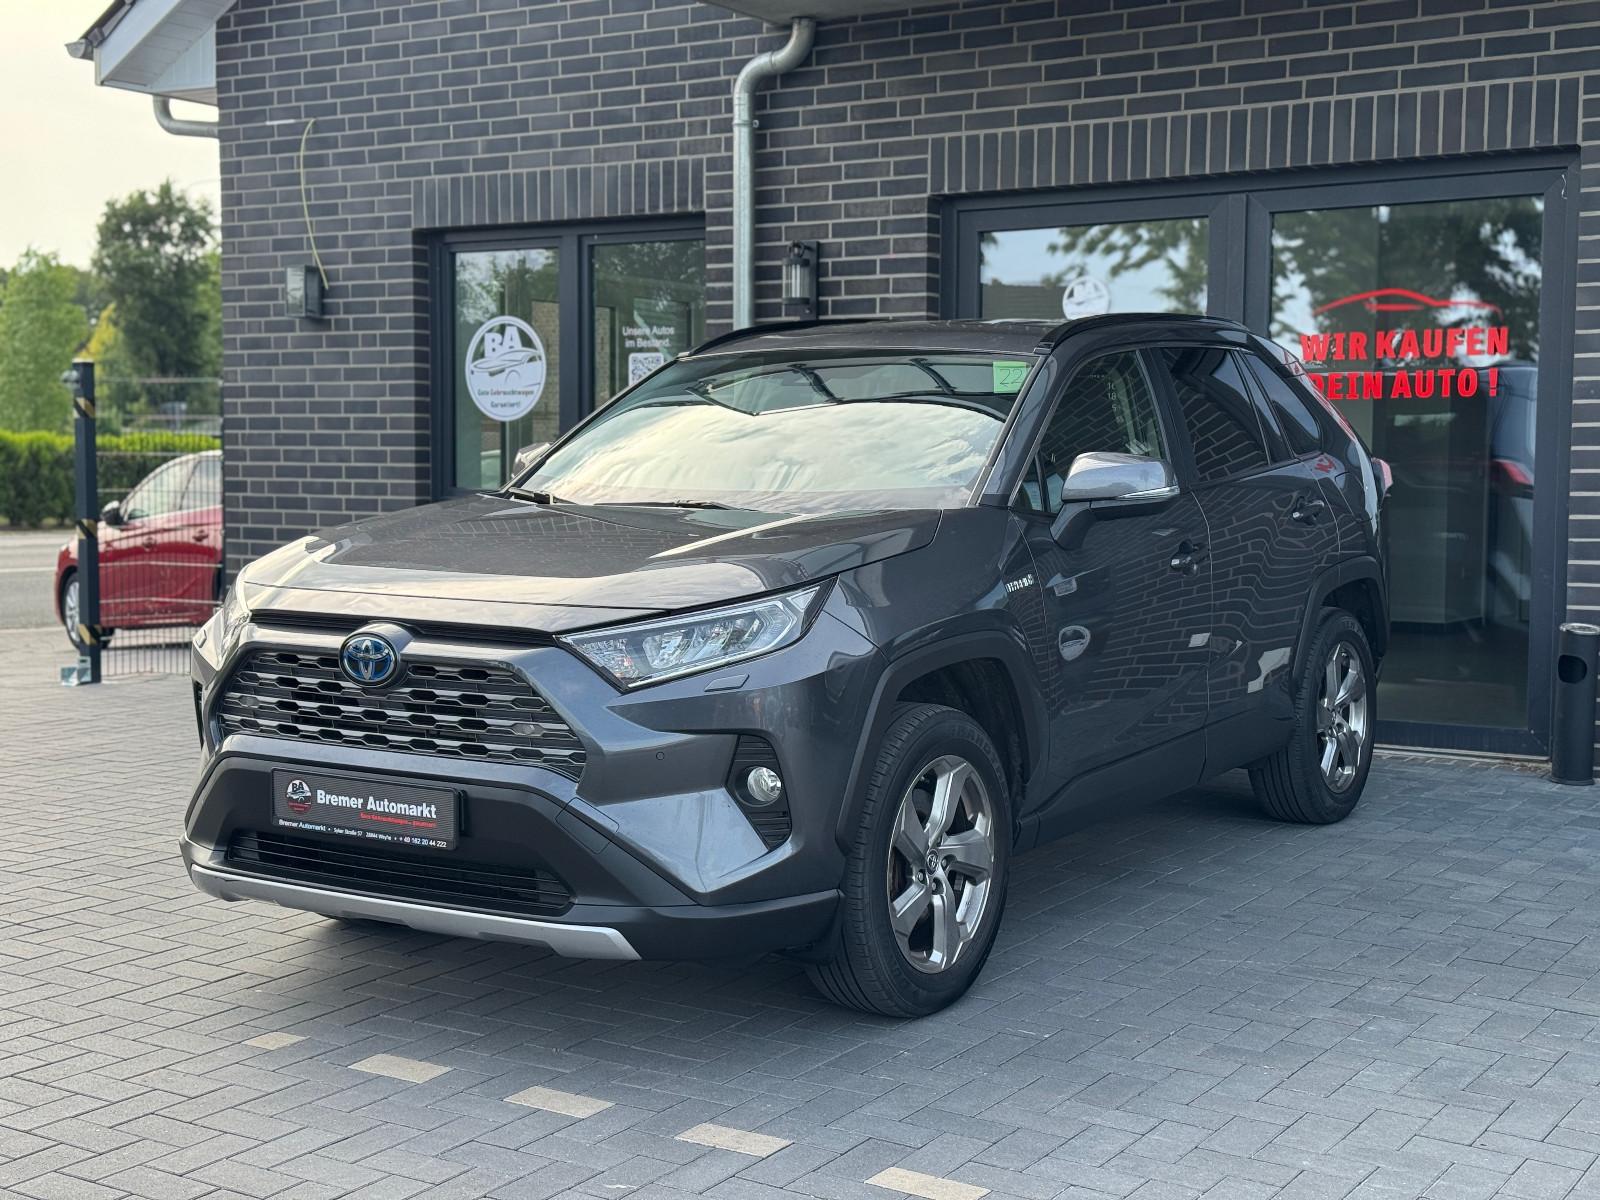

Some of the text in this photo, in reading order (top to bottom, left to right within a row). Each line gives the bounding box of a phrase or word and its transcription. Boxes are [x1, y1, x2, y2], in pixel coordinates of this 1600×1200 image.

[484, 326, 523, 359] BA
[625, 338, 636, 348] im
[651, 325, 675, 335] Autos
[1300, 327, 1509, 361] WIR KAUFEN
[999, 368, 1023, 386] 22
[1391, 368, 1478, 399] AUTO
[1488, 368, 1498, 397] !
[291, 782, 305, 792] BA
[316, 789, 363, 809] Bremer
[367, 796, 436, 819] Automarkt
[278, 819, 298, 828] Bremer
[299, 822, 326, 831] Automarkt
[436, 840, 447, 848] 222
